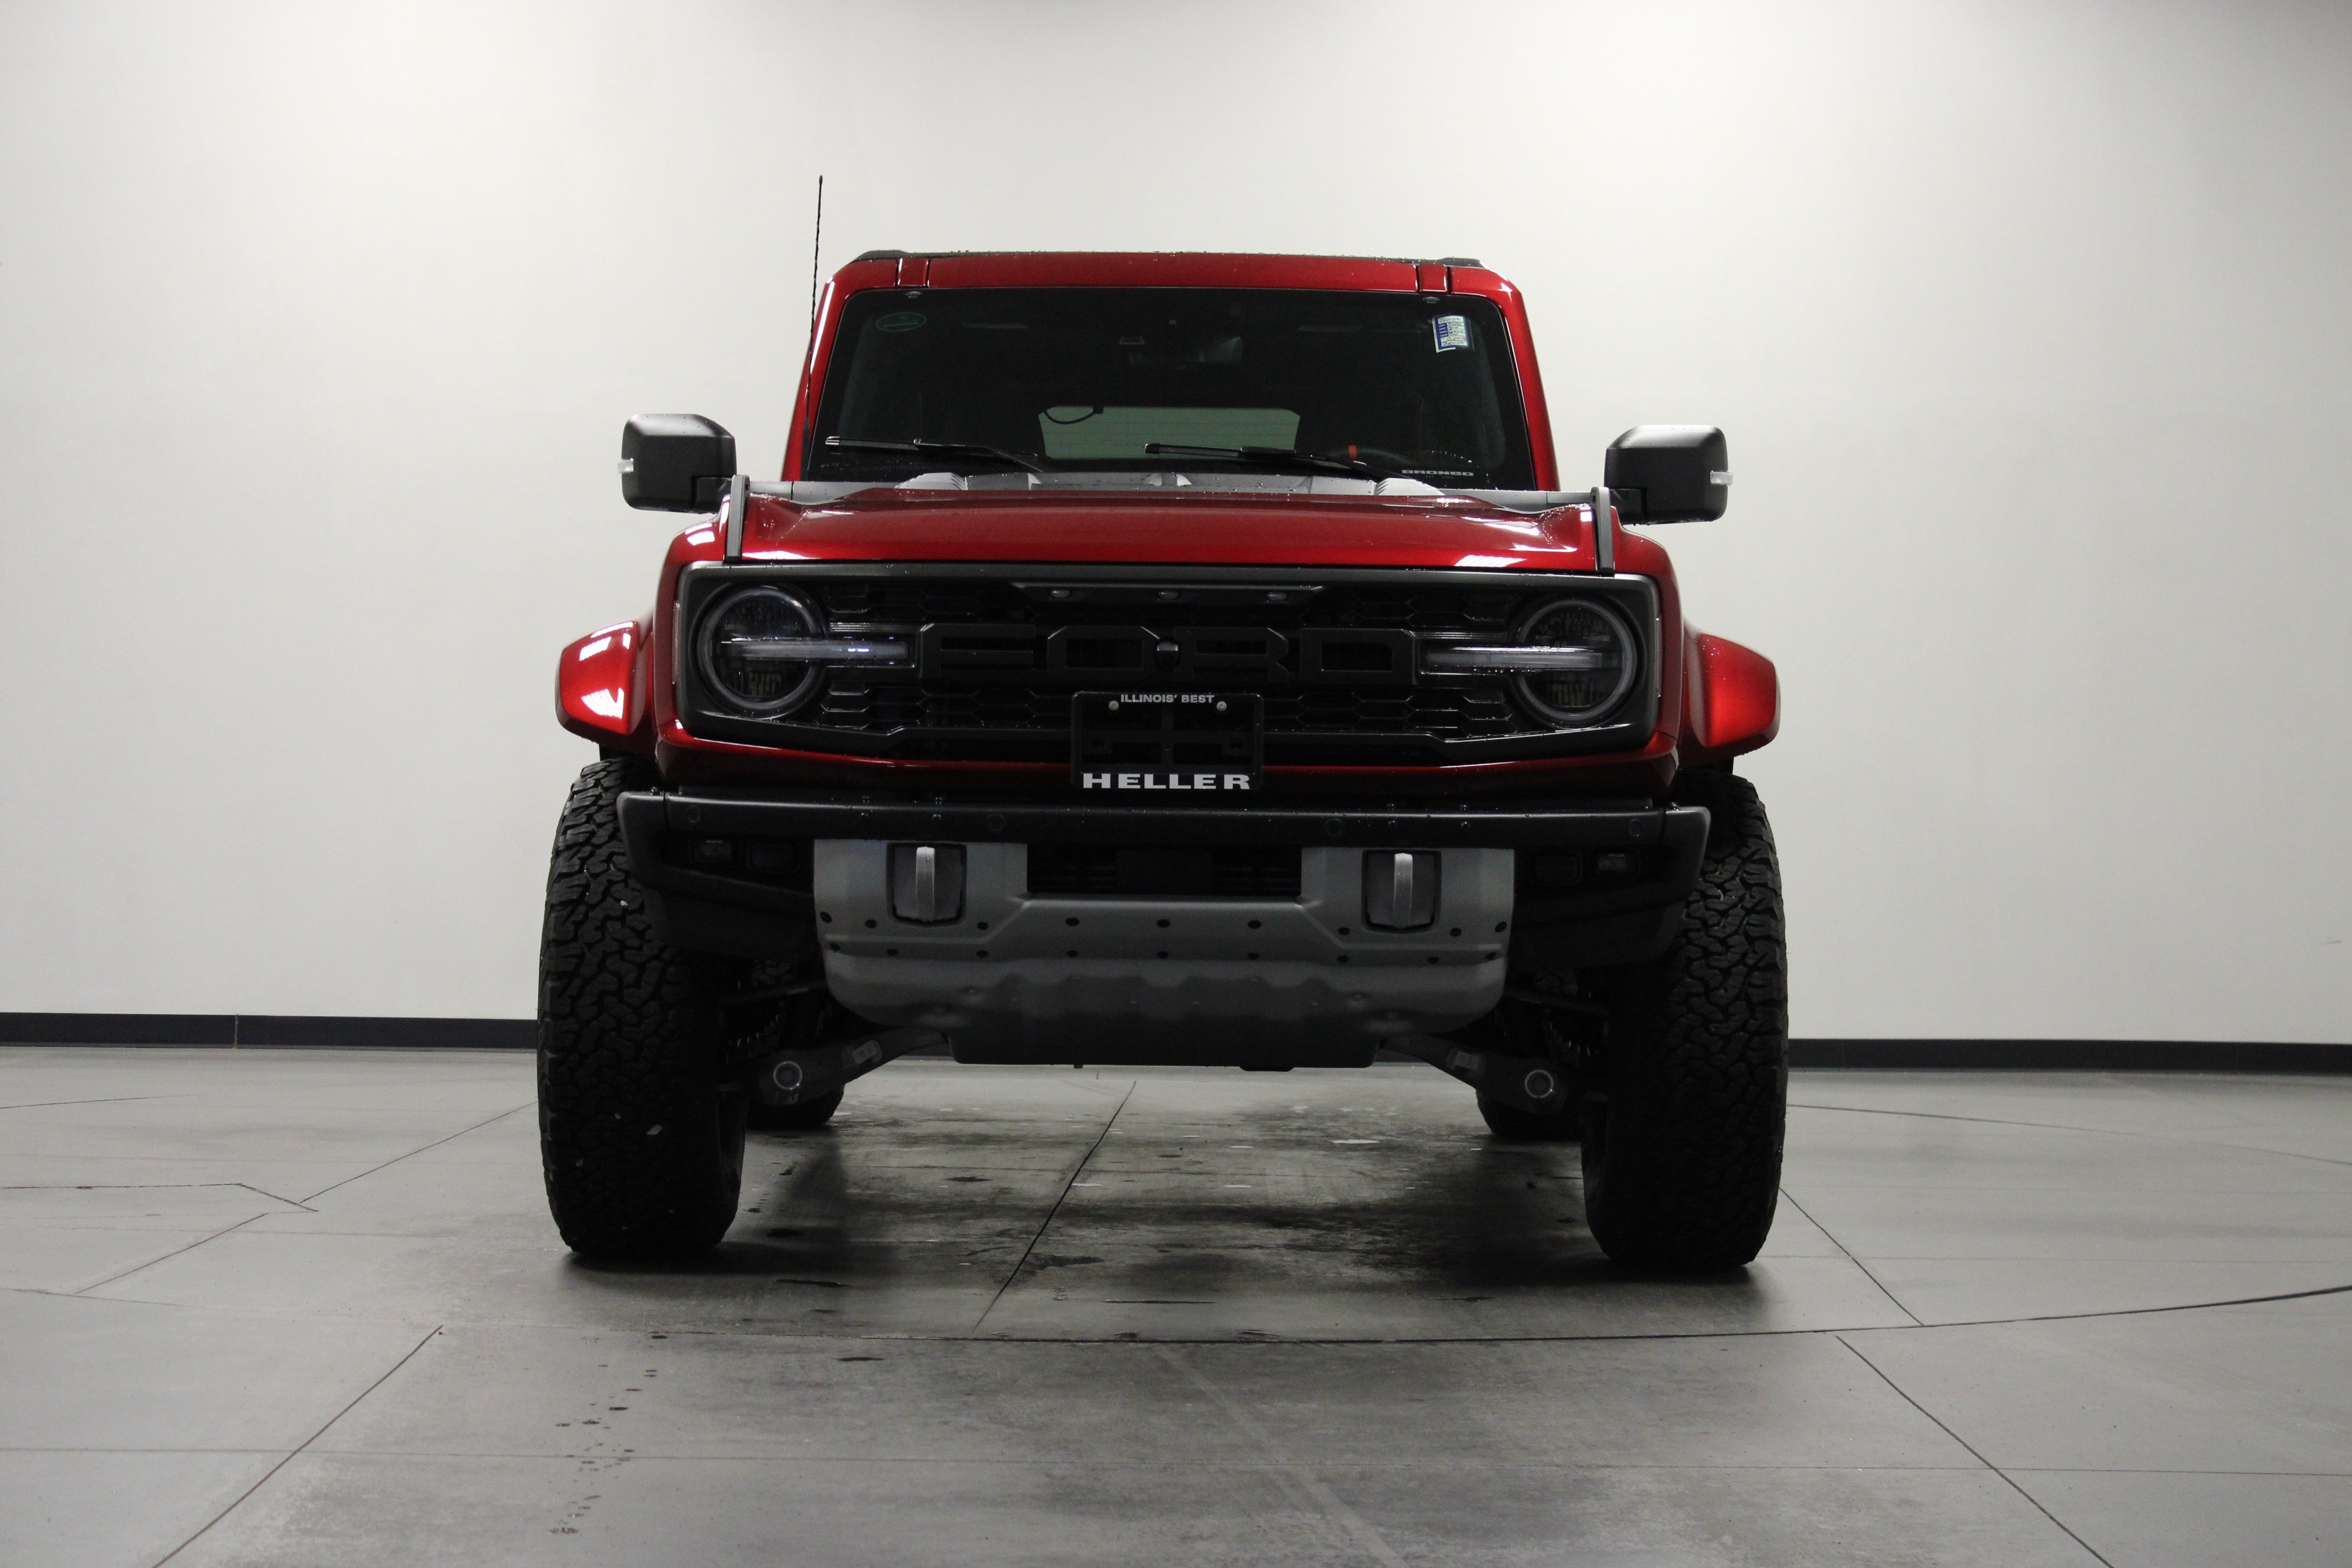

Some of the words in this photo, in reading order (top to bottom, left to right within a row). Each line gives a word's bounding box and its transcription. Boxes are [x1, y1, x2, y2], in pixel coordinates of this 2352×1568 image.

[919, 623, 1416, 685] FORD
[1121, 694, 1178, 703] ILLINOIS'
[1181, 695, 1215, 703] BEST
[1083, 774, 1250, 789] HELLER
